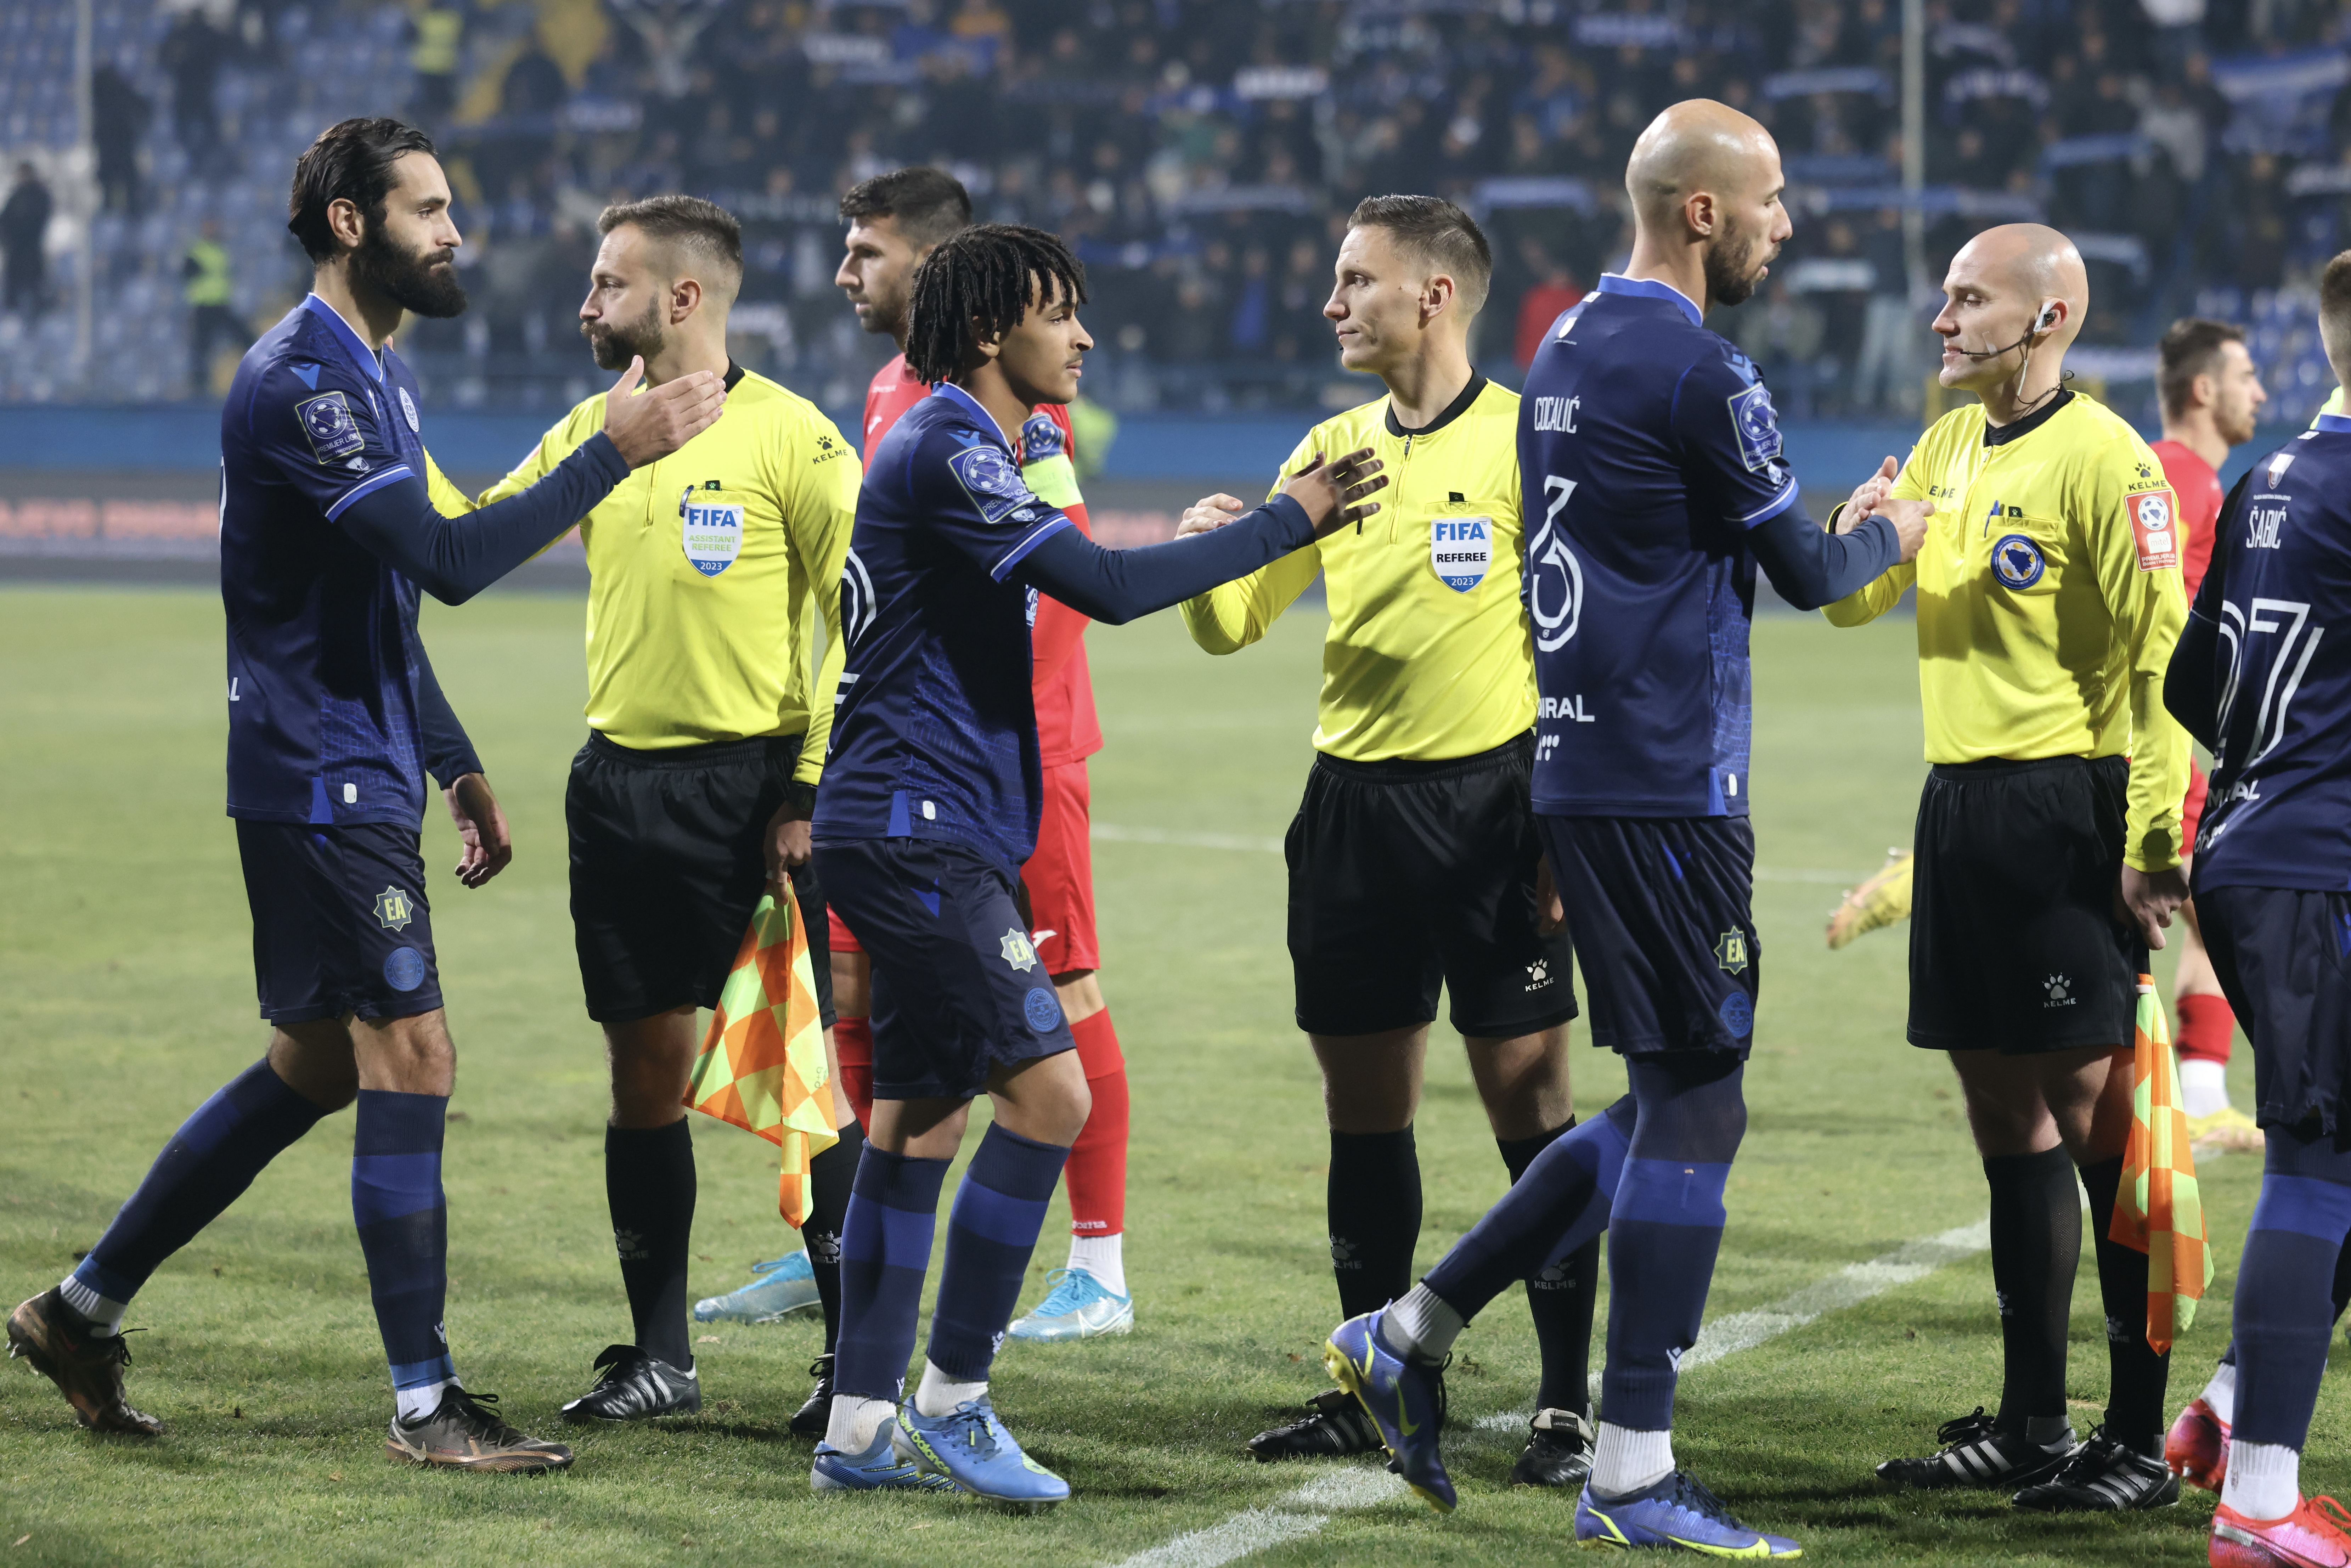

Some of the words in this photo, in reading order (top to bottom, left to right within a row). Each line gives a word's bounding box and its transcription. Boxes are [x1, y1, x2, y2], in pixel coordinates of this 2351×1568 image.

[1534, 395, 1580, 434] COCALIĆ
[813, 449, 848, 465] KELME
[2128, 480, 2167, 491] KELME
[689, 508, 737, 527] FIFA
[1436, 523, 1486, 541] FIFA
[2246, 505, 2287, 549] ŠABIĆ
[688, 534, 736, 543] ASSISTANT
[692, 543, 732, 552] REFEREE
[1437, 552, 1487, 563] REFEREE
[700, 562, 722, 571] 2023
[1451, 577, 1474, 586] 2023
[384, 896, 407, 921] EA
[1009, 938, 1033, 963] EA
[1726, 937, 1744, 963] EA
[1525, 976, 1555, 992] KELME
[2044, 997, 2076, 1008] KELME
[1534, 1279, 1576, 1290] KELME
[910, 1430, 952, 1474] balance
